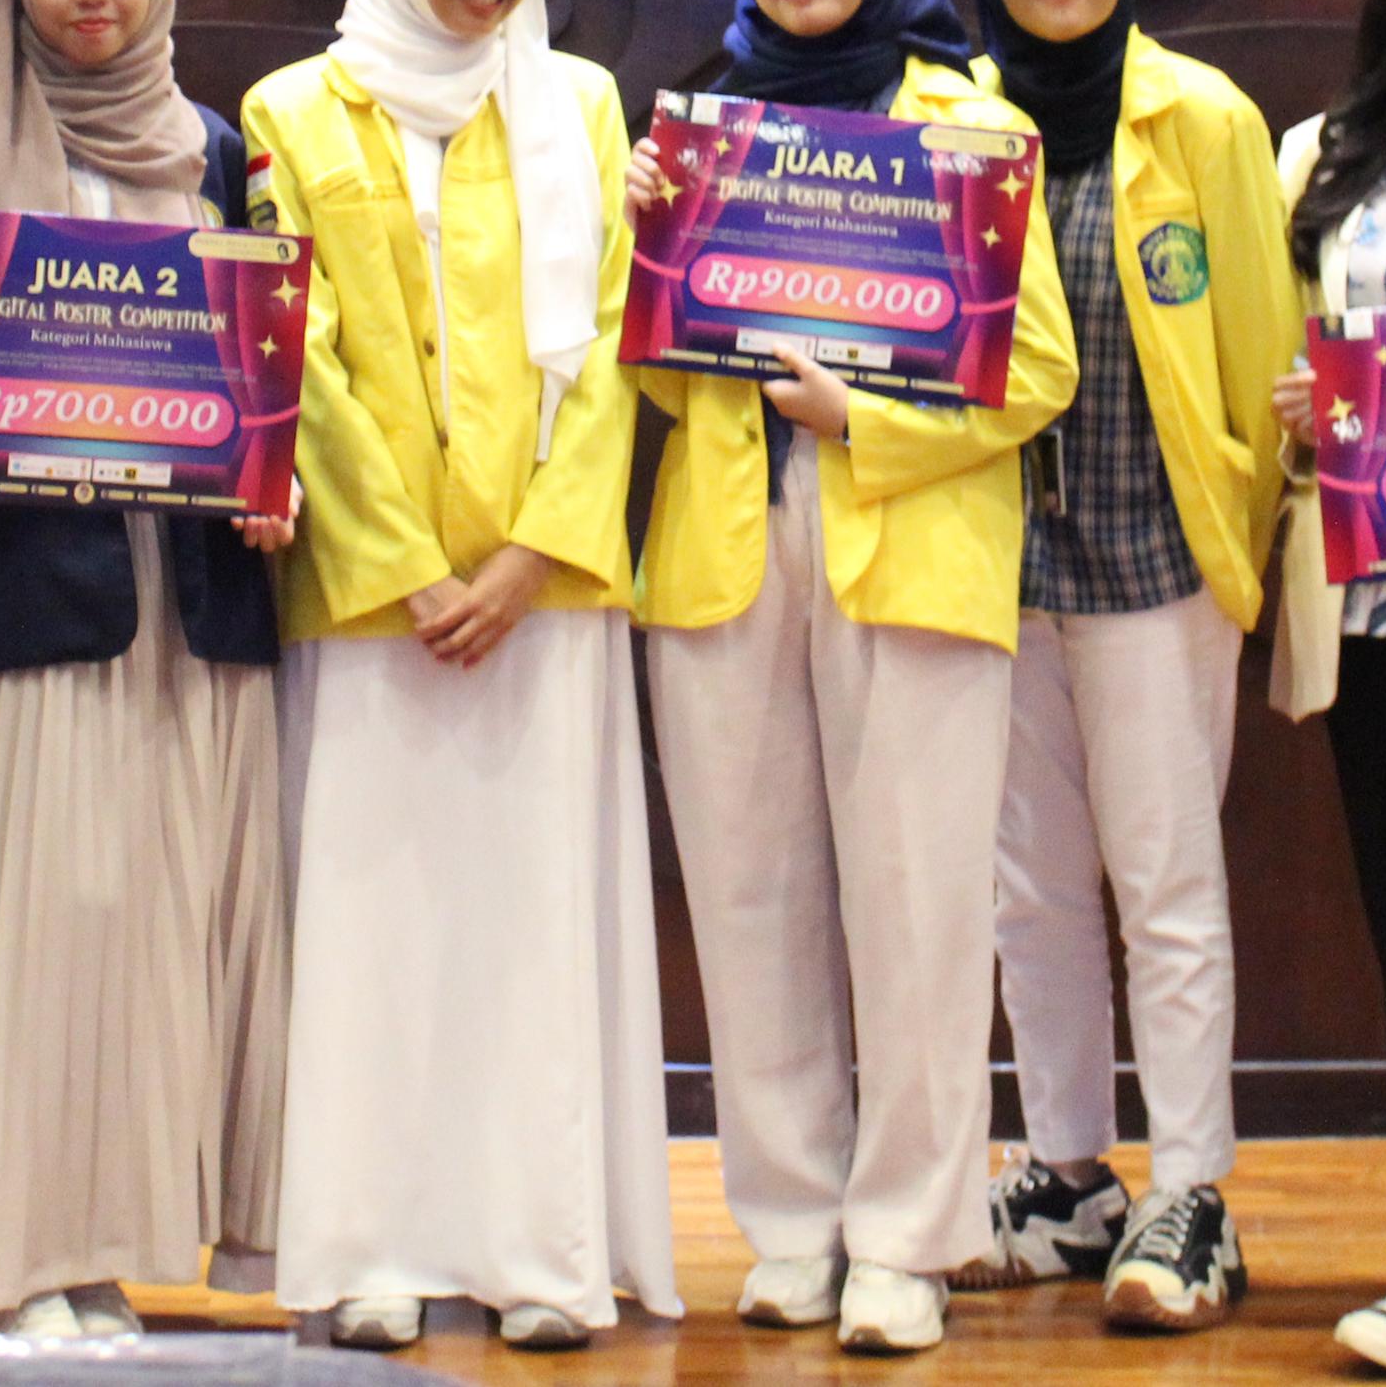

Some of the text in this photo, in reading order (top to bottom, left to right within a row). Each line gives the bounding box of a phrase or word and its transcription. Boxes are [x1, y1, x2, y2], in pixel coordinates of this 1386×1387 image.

[767, 145, 904, 185] JUARA 1
[764, 210, 899, 238] Kategori Mahasiswa
[27, 257, 178, 296] JUARA 2
[703, 261, 943, 318] Rp900.000
[54, 300, 112, 326] POSTER
[119, 303, 227, 333] COMPETITION
[31, 328, 173, 352] Kategori Mahasiswa
